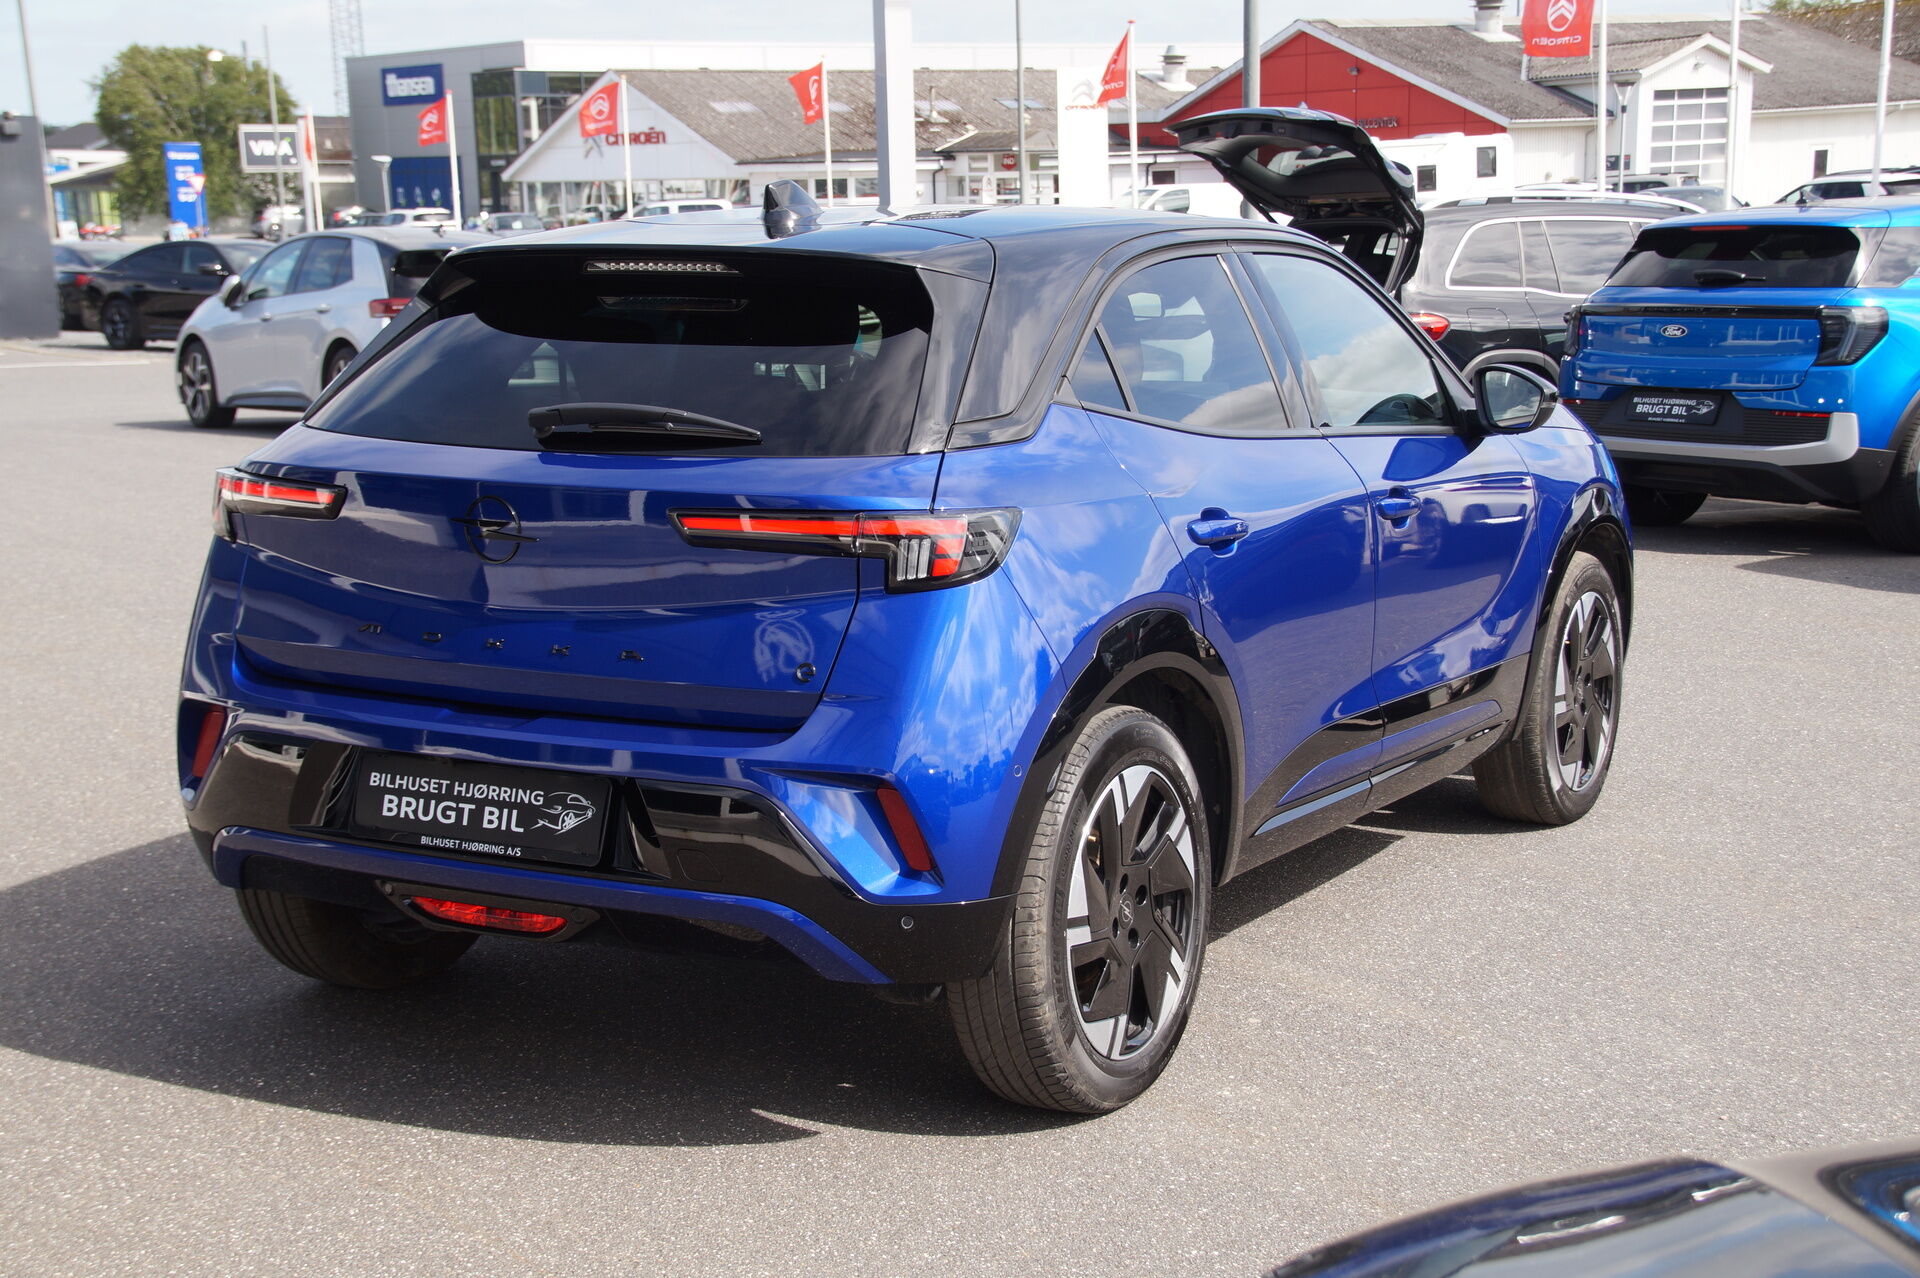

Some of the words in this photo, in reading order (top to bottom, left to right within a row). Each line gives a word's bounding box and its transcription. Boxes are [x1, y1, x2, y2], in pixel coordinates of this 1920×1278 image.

[1636, 404, 1671, 414] BRUGT
[1671, 405, 1688, 416] BIL
[1662, 398, 1697, 406] HJØRRING
[369, 772, 450, 795] BILHUSET
[453, 781, 545, 806] HJØRRING
[382, 794, 476, 827] BRUGT
[482, 806, 525, 834] BIL
[420, 835, 461, 850] BILHUSET
[462, 840, 505, 855] HJØRRING
[506, 847, 522, 857] A/S
